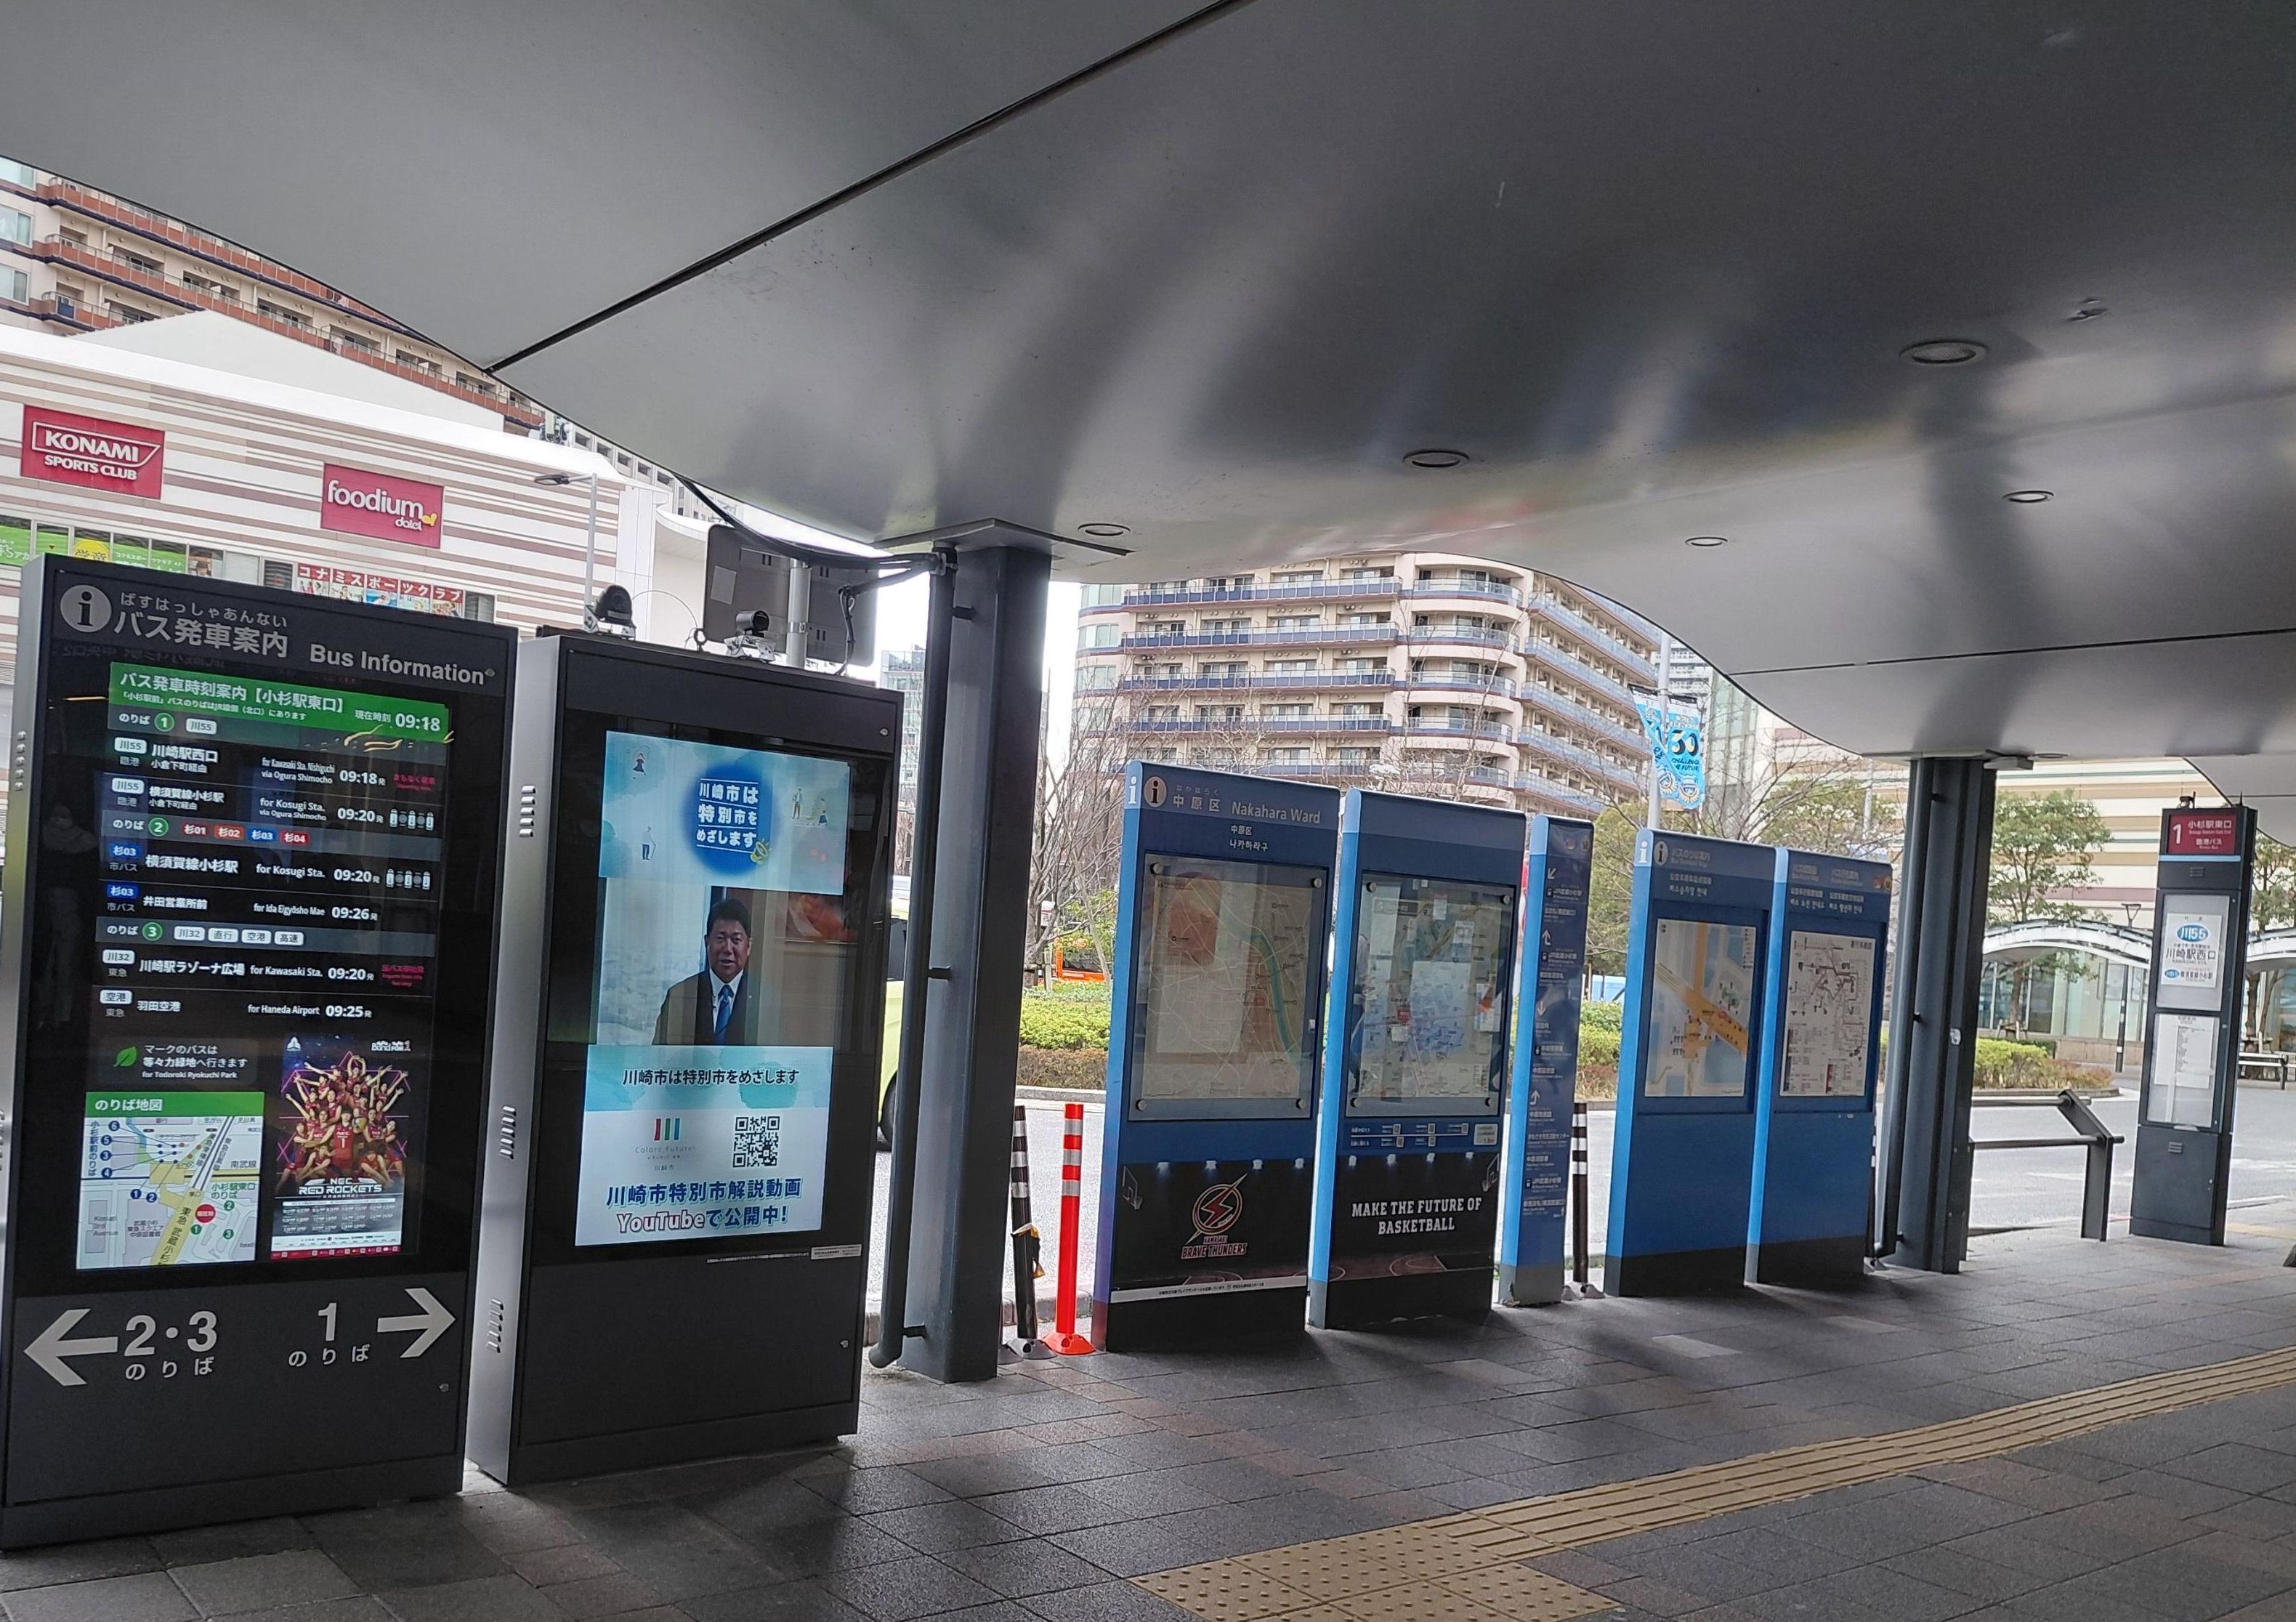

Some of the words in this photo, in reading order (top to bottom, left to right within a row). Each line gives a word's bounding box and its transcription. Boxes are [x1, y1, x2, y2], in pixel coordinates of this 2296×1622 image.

[45, 430, 139, 463] KONAMI
[44, 454, 99, 476] SPORTS
[100, 464, 137, 481] CLUB
[328, 480, 424, 520] foodium
[299, 565, 462, 602] コナミスポーツクラブ
[120, 592, 288, 628] ばすはっしゃあんない
[114, 610, 289, 658] バス発車案内
[310, 642, 356, 668] Bus
[361, 650, 485, 685] Information
[118, 713, 150, 725] のりば
[190, 721, 212, 731] 川55
[355, 709, 391, 723] 現在時刻
[395, 713, 441, 732] 09:18
[120, 740, 142, 750] 川55
[151, 744, 218, 763] 川崎駅西口
[262, 757, 270, 767] for
[117, 780, 139, 791] 川55
[274, 771, 296, 781] Ogura
[297, 773, 333, 784] Shimocho
[699, 781, 759, 804] 川崎市は
[1176, 784, 1218, 796] なかはらく
[260, 797, 272, 807] for
[276, 799, 306, 812] Kosugi
[308, 802, 326, 812] Sta.
[1173, 794, 1221, 812] 中原区
[1232, 801, 1287, 820] Nakahara
[1290, 808, 1321, 825] Ward
[272, 810, 293, 820] Ogura
[293, 812, 326, 822] Shimocho
[698, 803, 758, 826] 特別市を
[113, 819, 145, 831] のりば
[185, 824, 206, 835] 杉01
[218, 827, 240, 838] 杉02
[252, 830, 273, 840] 杉03
[284, 833, 306, 843] 杉04
[2188, 819, 2232, 829] 小杉駅東口
[696, 828, 757, 849] めざします
[2172, 823, 2182, 844] 1
[109, 862, 138, 872] 市バス
[113, 845, 137, 857] 杉03
[145, 854, 239, 874] 横須賀線小杉駅
[256, 863, 271, 873] for
[273, 865, 305, 878] Kosugi
[307, 868, 326, 878] Sta.
[110, 886, 134, 897] 杉03
[107, 902, 136, 912] 市バス
[254, 903, 264, 912] for
[266, 904, 277, 913] Ida
[310, 908, 326, 916] Mae
[107, 925, 139, 936] のりば
[178, 929, 201, 938] 川32
[214, 930, 233, 940] 直行
[247, 932, 266, 941] 空港
[280, 934, 299, 943] 高速
[2179, 926, 2207, 940] 川55
[2165, 947, 2216, 960] 川崎駅西口
[108, 953, 129, 962] 川32
[139, 959, 245, 976] 川崎駅ラゾーナ広場
[108, 967, 128, 977] 東急
[250, 965, 264, 975] for
[265, 966, 306, 977] Kawasaki
[307, 968, 323, 977] Sta.
[106, 992, 126, 1001] 空港
[137, 1000, 181, 1012] 羽田空港
[248, 1004, 260, 1014] for
[262, 1005, 291, 1014] Haneda
[292, 1006, 320, 1017] Airport
[144, 1044, 218, 1054] マークのバスは
[142, 1057, 248, 1068] 等々力緑地へ行きます
[188, 1071, 219, 1080] Ryokuchi
[622, 1069, 800, 1086] 川崎市は特別市をめざします
[95, 1098, 163, 1112] のりば地図
[211, 1182, 256, 1191] 小杉駅東口
[298, 1186, 324, 1195] RED
[326, 1185, 383, 1194] ROCKETS
[606, 1177, 802, 1207] 川崎市特別市解説動画
[1351, 1201, 1388, 1217] MAKE
[1391, 1200, 1414, 1215] THE
[1418, 1198, 1464, 1214] FUTURE
[1466, 1197, 1482, 1211] OF
[1378, 1216, 1455, 1235] BASKETBALL
[1181, 1246, 1207, 1258] BRAVE
[1208, 1243, 1248, 1256] THUNDERS
[318, 1302, 338, 1342] 1
[288, 1343, 372, 1367] のりば
[125, 1356, 214, 1381] のりば
